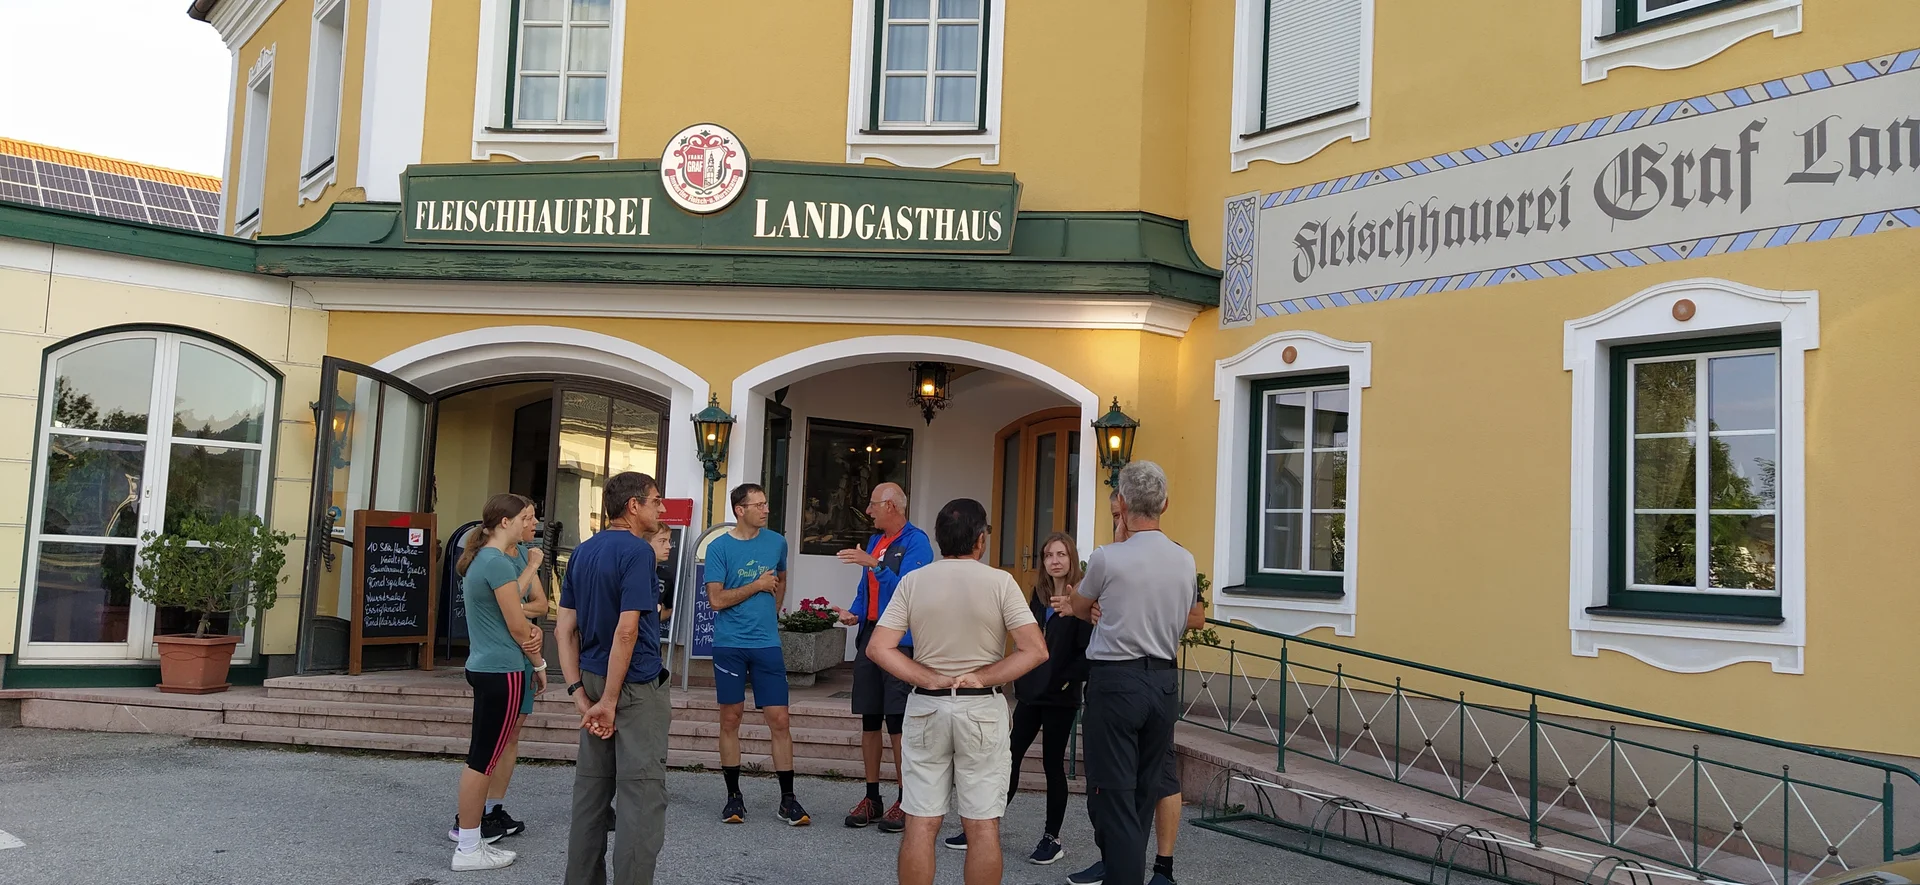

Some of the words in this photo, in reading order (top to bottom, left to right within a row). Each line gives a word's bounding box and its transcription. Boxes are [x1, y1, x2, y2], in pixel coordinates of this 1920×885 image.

[687, 161, 704, 173] GRAF
[1292, 167, 1574, 284] Fleischhauerei
[1593, 116, 1769, 233] Graf
[415, 197, 652, 236] FLEISCHHAUEREI
[753, 198, 1002, 242] LANDGASTHAUS
[367, 542, 378, 553] 10
[407, 566, 427, 578] gratis
[365, 591, 408, 602] Wurstsalat
